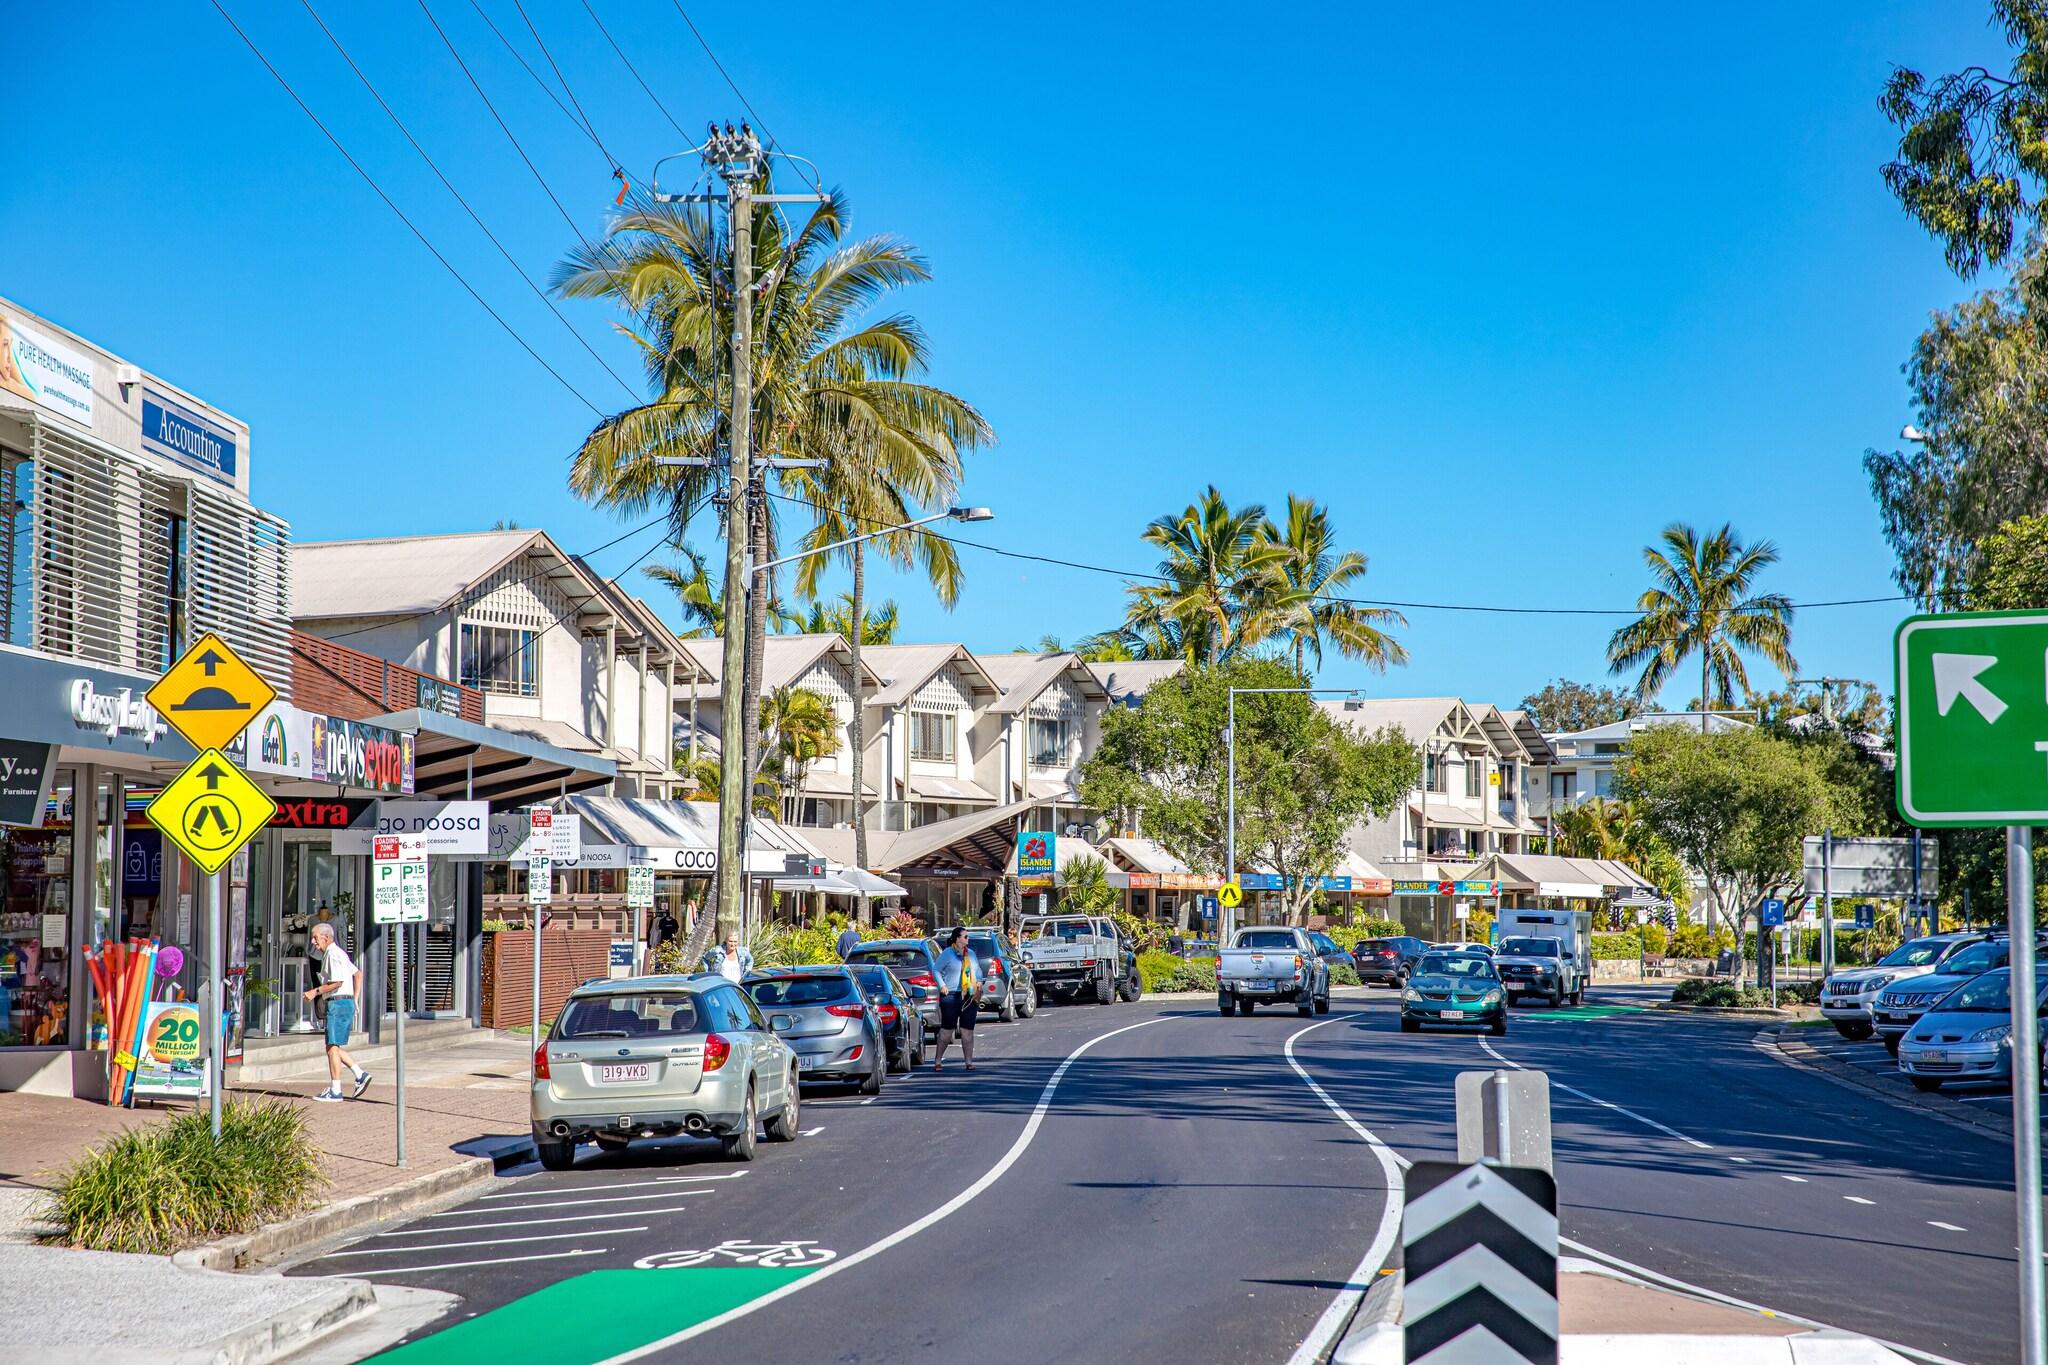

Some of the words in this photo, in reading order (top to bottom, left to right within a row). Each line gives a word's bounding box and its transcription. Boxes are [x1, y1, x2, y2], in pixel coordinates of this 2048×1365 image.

[19, 341, 36, 364] PURE
[38, 351, 62, 376] HEALTH
[62, 362, 91, 390] MASSAGE
[159, 407, 222, 476] Accounting
[365, 732, 401, 792] extra
[3, 787, 38, 796] Furniture
[268, 799, 348, 827] extra
[378, 816, 405, 834] go
[413, 816, 480, 831] noosa
[375, 837, 399, 845] LOADING
[425, 837, 458, 845] ccessories
[379, 844, 394, 852] ZONE
[587, 853, 612, 861] NOOSA
[675, 850, 717, 869] COCO
[1020, 858, 1052, 867] ISLANDER
[382, 866, 392, 880] P
[1768, 901, 1778, 913] P
[157, 1017, 199, 1042] 20
[155, 1041, 197, 1050] MILLION
